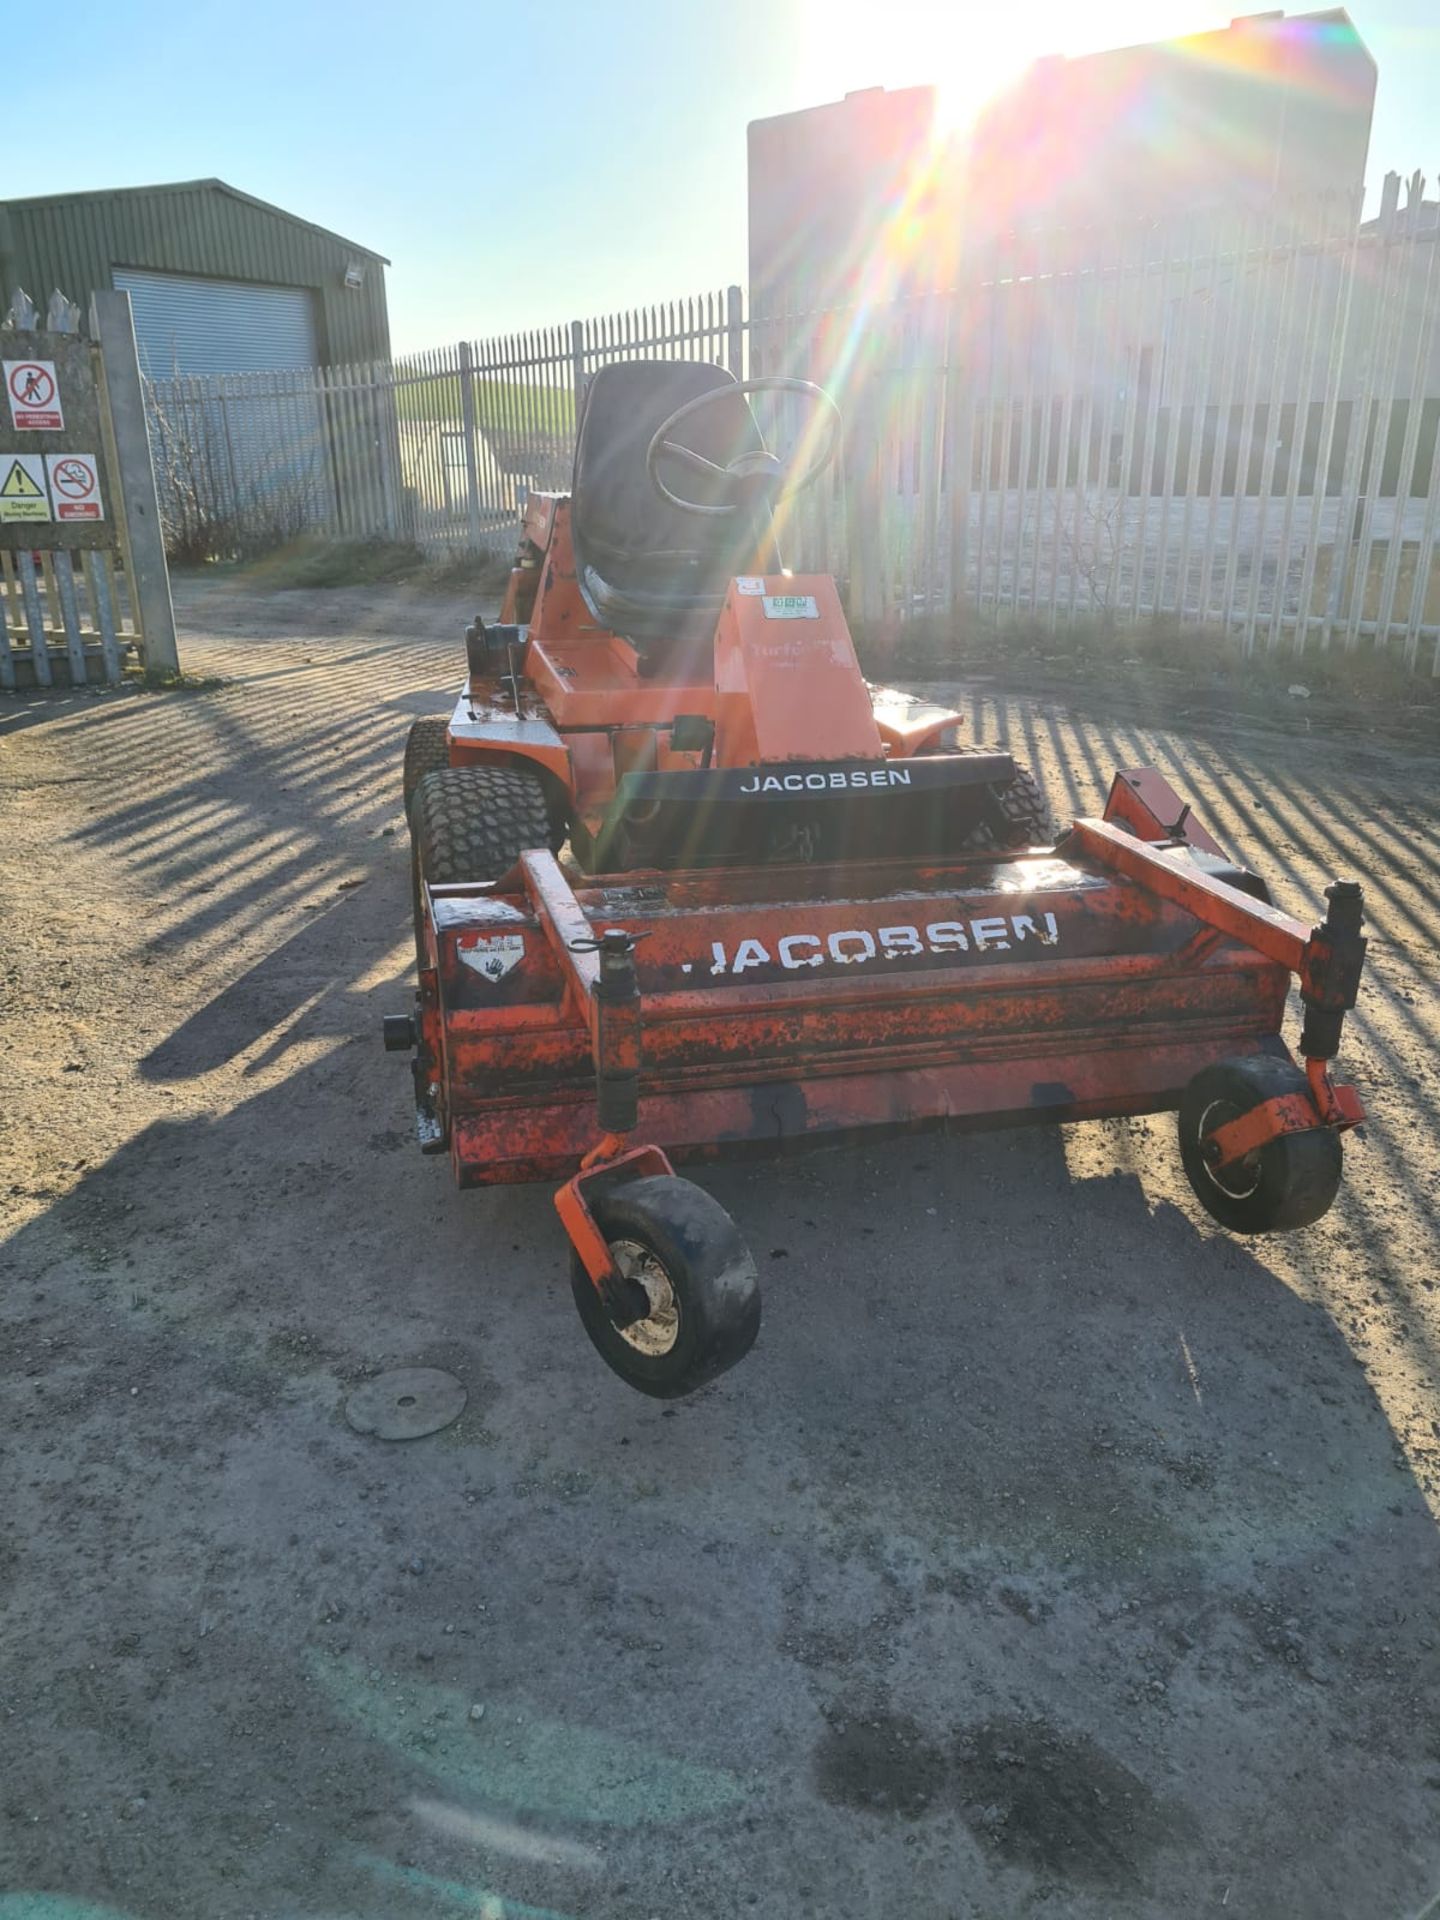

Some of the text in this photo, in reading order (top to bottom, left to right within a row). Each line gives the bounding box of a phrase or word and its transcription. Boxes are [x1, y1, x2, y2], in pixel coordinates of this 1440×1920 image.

[11, 501, 37, 510] Danger
[740, 769, 912, 793] JACOBSEN
[682, 912, 1058, 976] JACOBSEN
